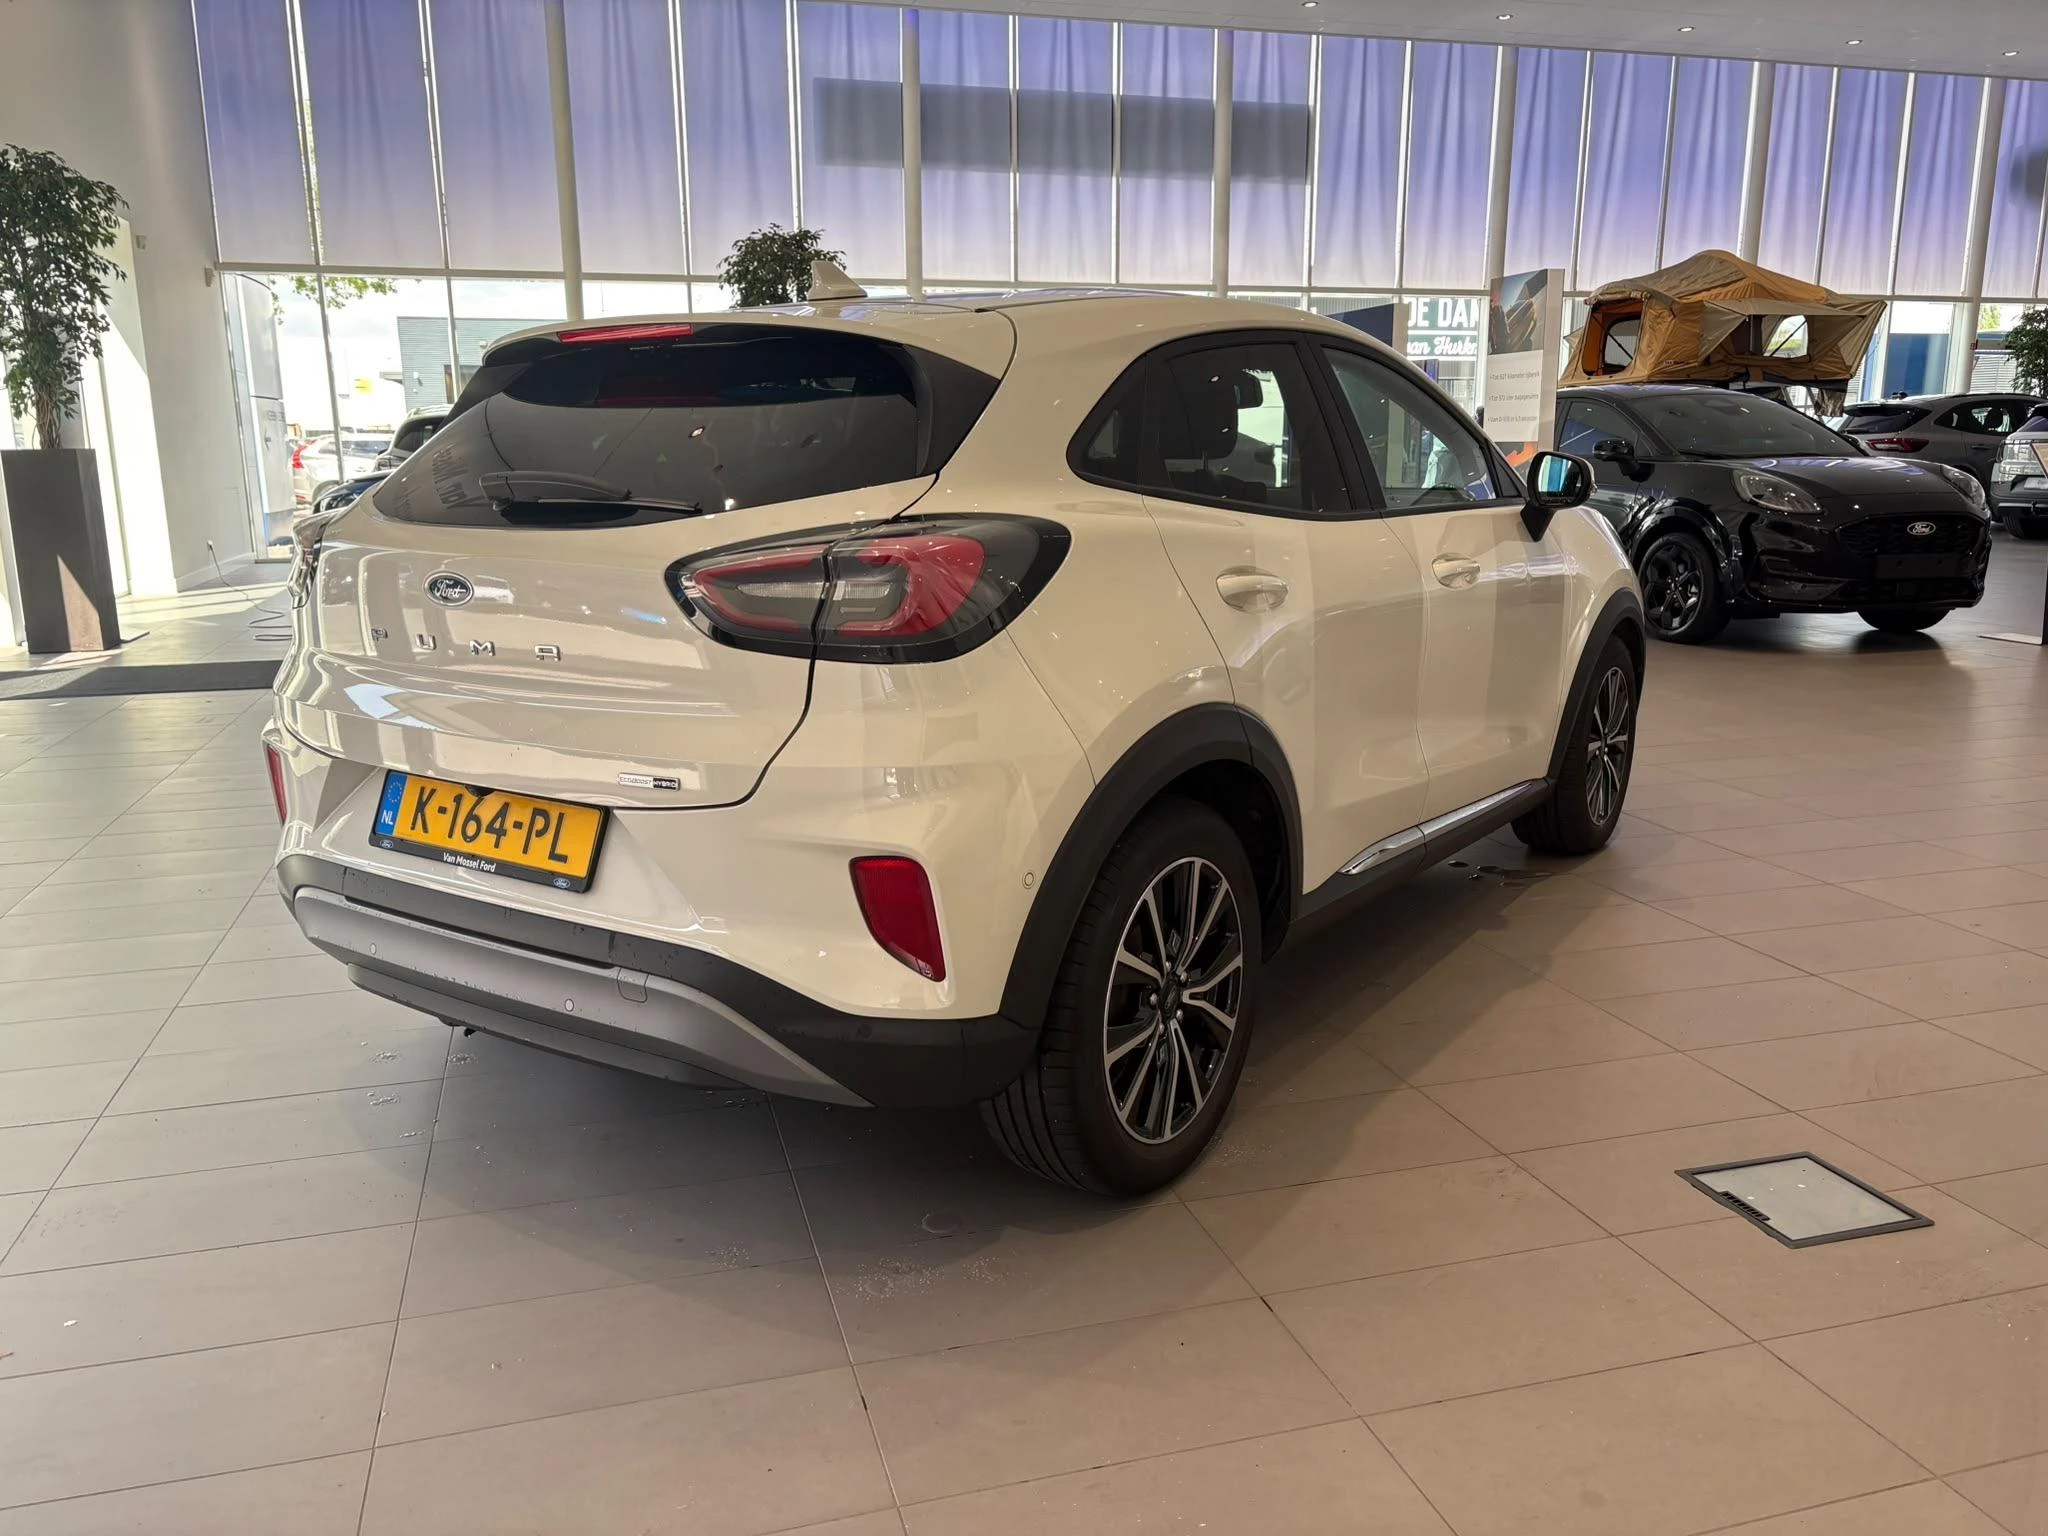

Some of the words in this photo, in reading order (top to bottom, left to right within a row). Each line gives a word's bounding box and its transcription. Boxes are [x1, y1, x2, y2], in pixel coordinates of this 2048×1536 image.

[433, 578, 468, 599] Ford
[381, 810, 394, 825] NL
[410, 786, 568, 864] K-164-PL
[443, 852, 455, 863] Van
[456, 855, 480, 869] Mossel
[480, 860, 497, 873] Ford
